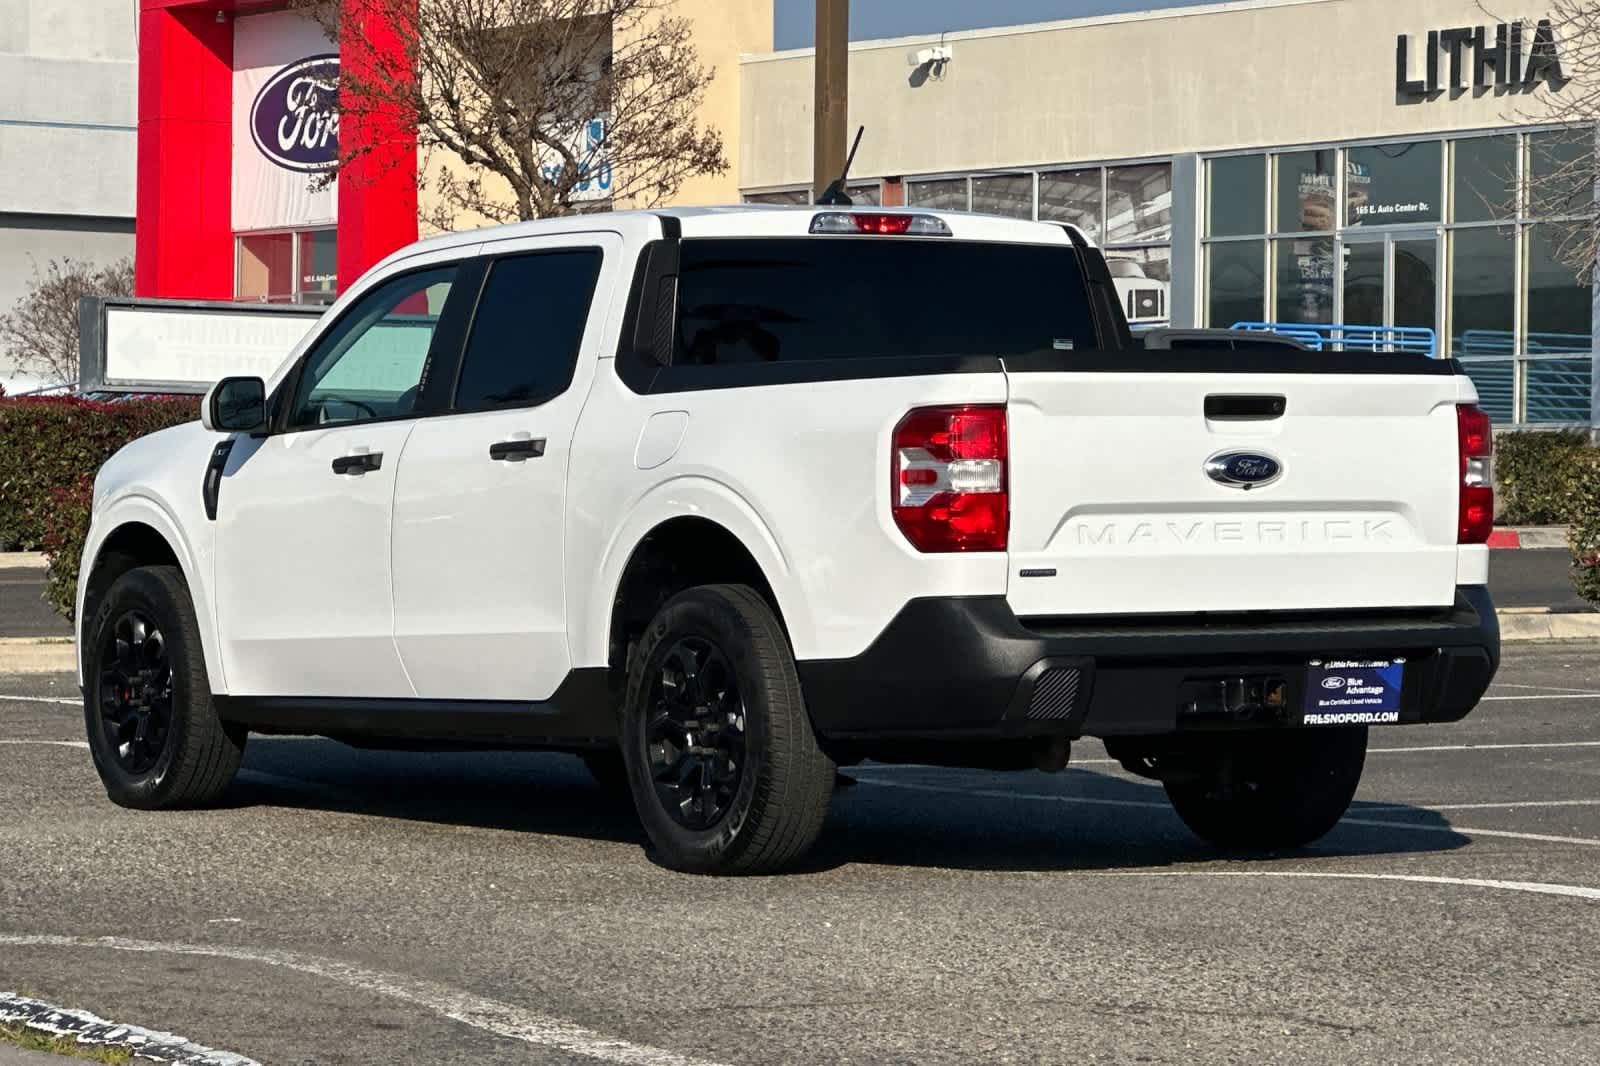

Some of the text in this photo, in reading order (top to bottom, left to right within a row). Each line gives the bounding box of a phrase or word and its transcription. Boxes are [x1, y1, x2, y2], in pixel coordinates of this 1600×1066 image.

[1396, 19, 1566, 94] LITHIA
[278, 76, 340, 151] For
[1356, 205, 1368, 214] 165
[1377, 204, 1394, 213] Auto
[1394, 203, 1418, 212] Center
[1419, 202, 1430, 211] Dr.
[1236, 459, 1268, 476] Ford
[1077, 519, 1394, 545] MAVERICK
[1347, 678, 1363, 686] Blue
[1346, 687, 1384, 695] Advantage
[1330, 698, 1351, 706] Certified
[1303, 712, 1399, 725] FRESNOFORD.COM
